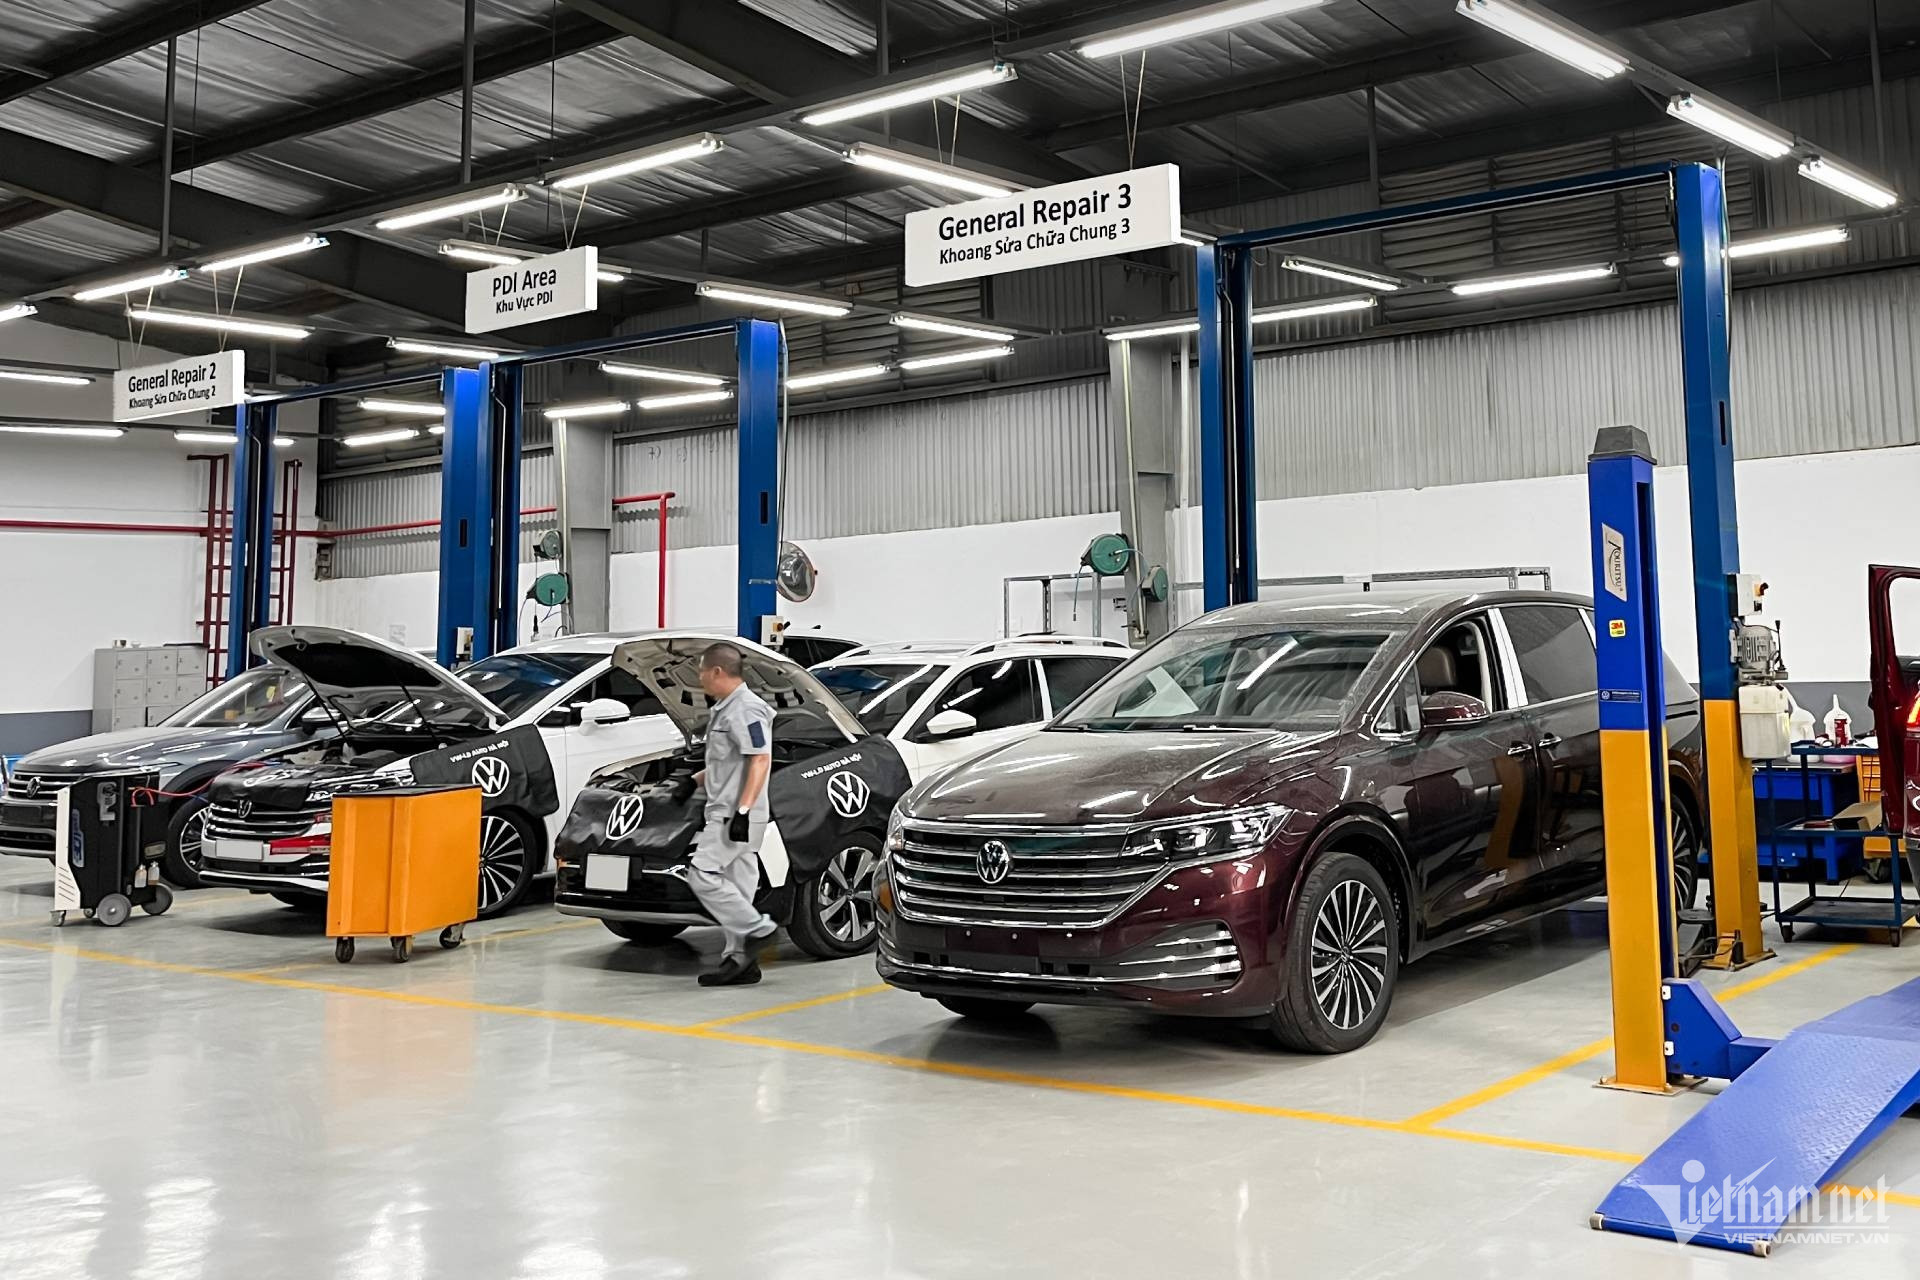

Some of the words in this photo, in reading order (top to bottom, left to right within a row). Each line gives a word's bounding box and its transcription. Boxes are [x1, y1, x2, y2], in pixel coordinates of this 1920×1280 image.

[938, 203, 1025, 241] General
[1033, 190, 1110, 226] Repair
[1117, 183, 1132, 209] 3
[939, 244, 992, 265] Khoang
[995, 235, 1022, 255] Sửa
[1027, 230, 1065, 250] Chữa
[1070, 220, 1117, 243] Chung
[1121, 218, 1131, 235] 3
[492, 272, 518, 298] PDI
[522, 268, 557, 291] Area
[496, 299, 514, 314] Khu
[515, 295, 535, 311] Vực
[536, 290, 553, 306] PDI
[128, 369, 169, 393] General
[171, 364, 207, 388] Repair
[209, 362, 217, 380] 2
[128, 396, 154, 409] Khoang
[188, 387, 211, 400] Chung
[211, 385, 216, 397] 2
